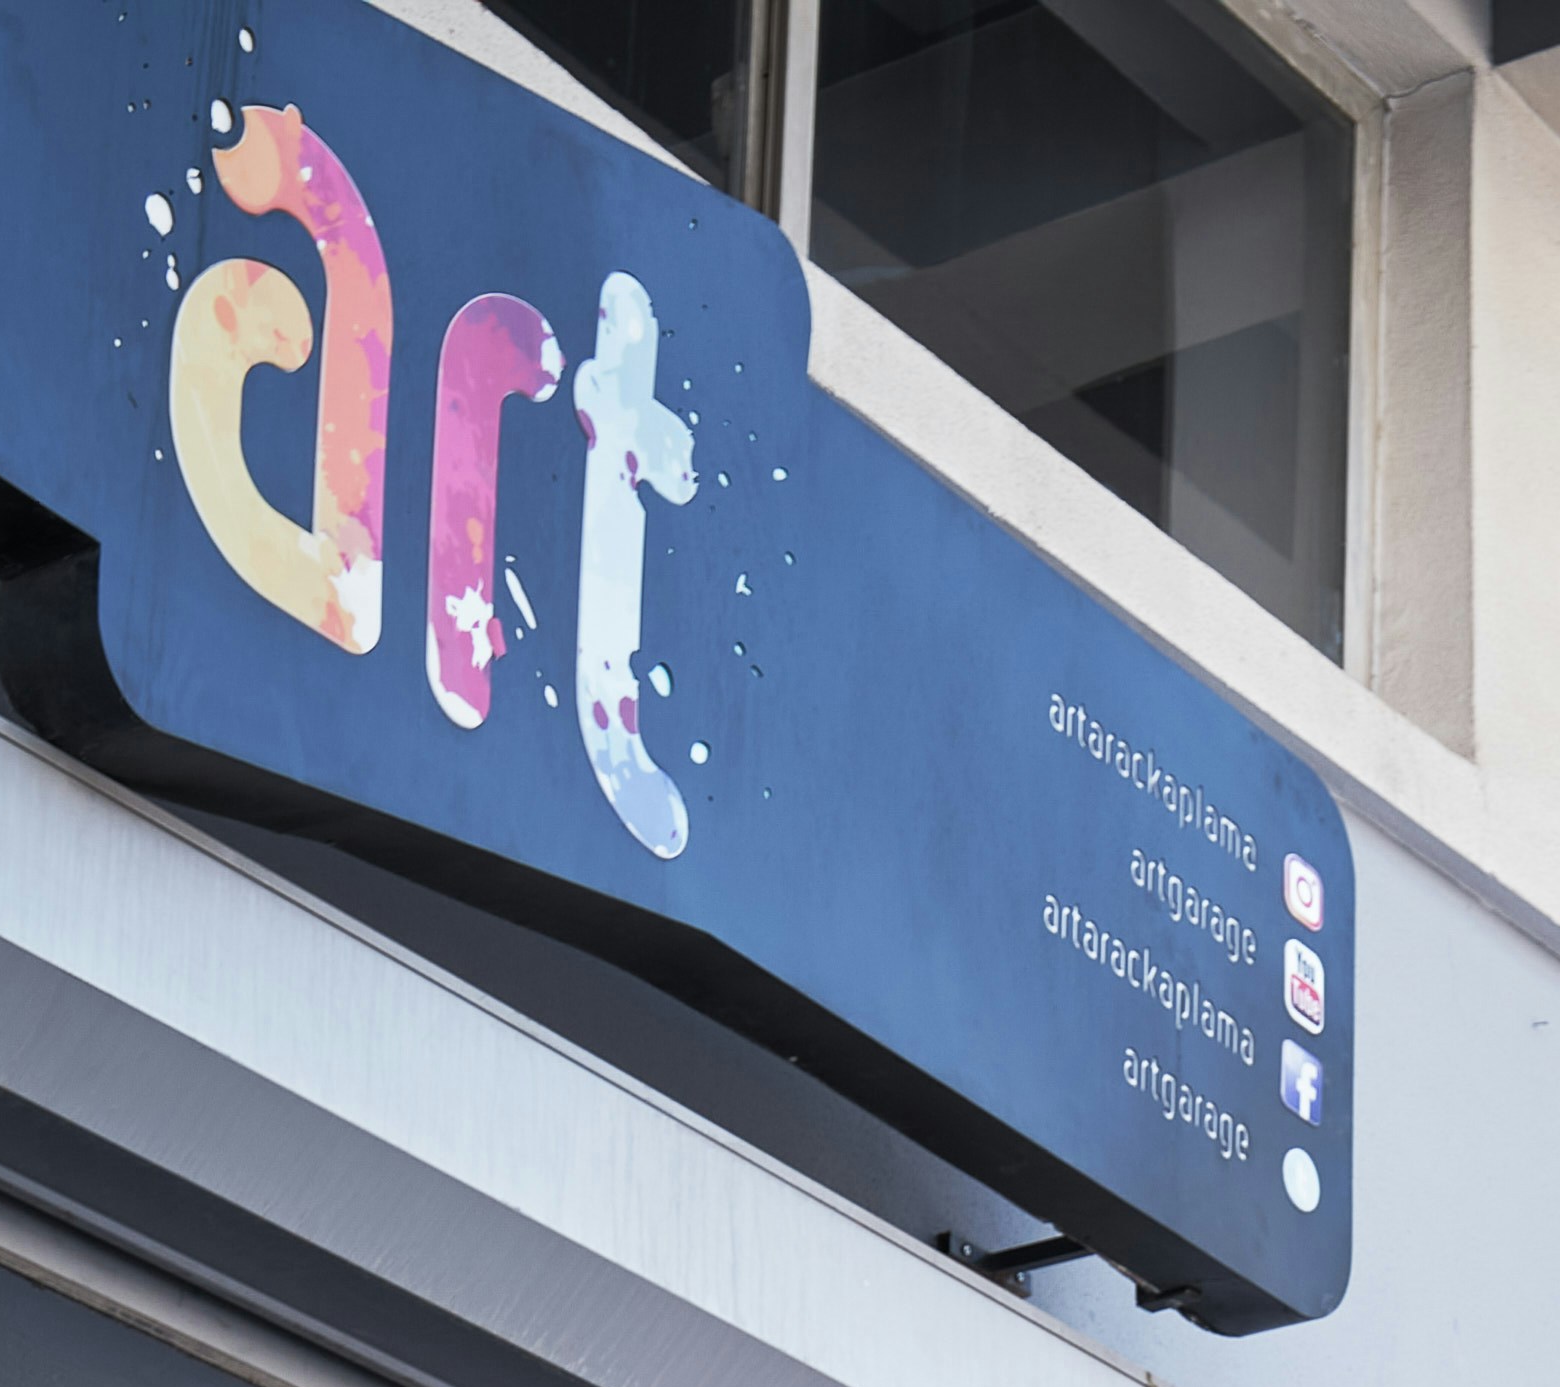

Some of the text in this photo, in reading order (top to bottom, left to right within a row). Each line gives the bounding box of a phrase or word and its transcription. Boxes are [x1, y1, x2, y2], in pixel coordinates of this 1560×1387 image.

[169, 103, 699, 860] art
[1049, 693, 1257, 872] artarackaplama
[1043, 894, 1255, 1067] artarackaplama
[1130, 848, 1257, 966] artgarage
[1123, 1047, 1249, 1161] artgarage
